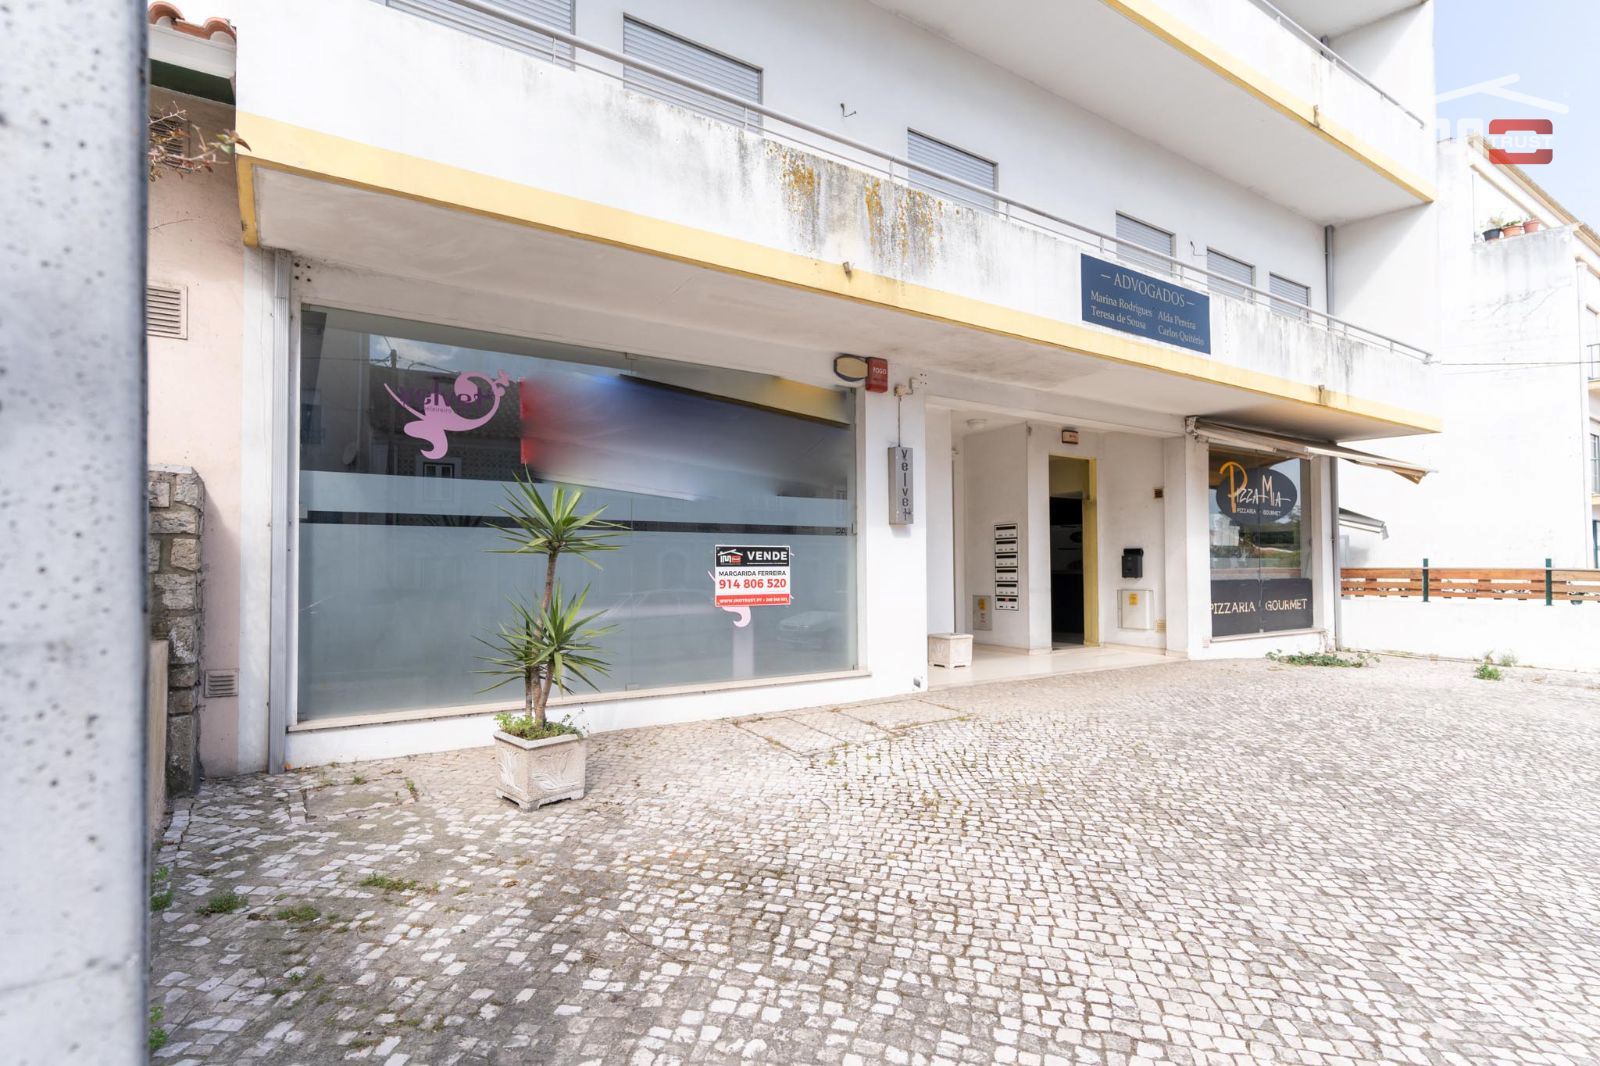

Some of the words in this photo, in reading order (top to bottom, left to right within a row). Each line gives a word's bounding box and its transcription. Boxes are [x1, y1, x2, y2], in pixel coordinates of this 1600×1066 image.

[1114, 273, 1185, 307] ADVOGADOS
[1090, 290, 1118, 307] Marina
[1119, 298, 1153, 318] Rodrigues
[1090, 305, 1115, 321] Teresa
[1116, 313, 1126, 324] de
[1126, 315, 1147, 330] Sousa
[1157, 312, 1174, 324] Alda
[1174, 315, 1197, 330] Pereira
[1157, 325, 1178, 340] Carlos
[901, 448, 912, 521] velvet
[747, 551, 788, 561] VENDE
[719, 579, 741, 589] 914
[743, 578, 764, 589] 806
[767, 578, 787, 588] 520
[1264, 598, 1308, 612] GOURMET
